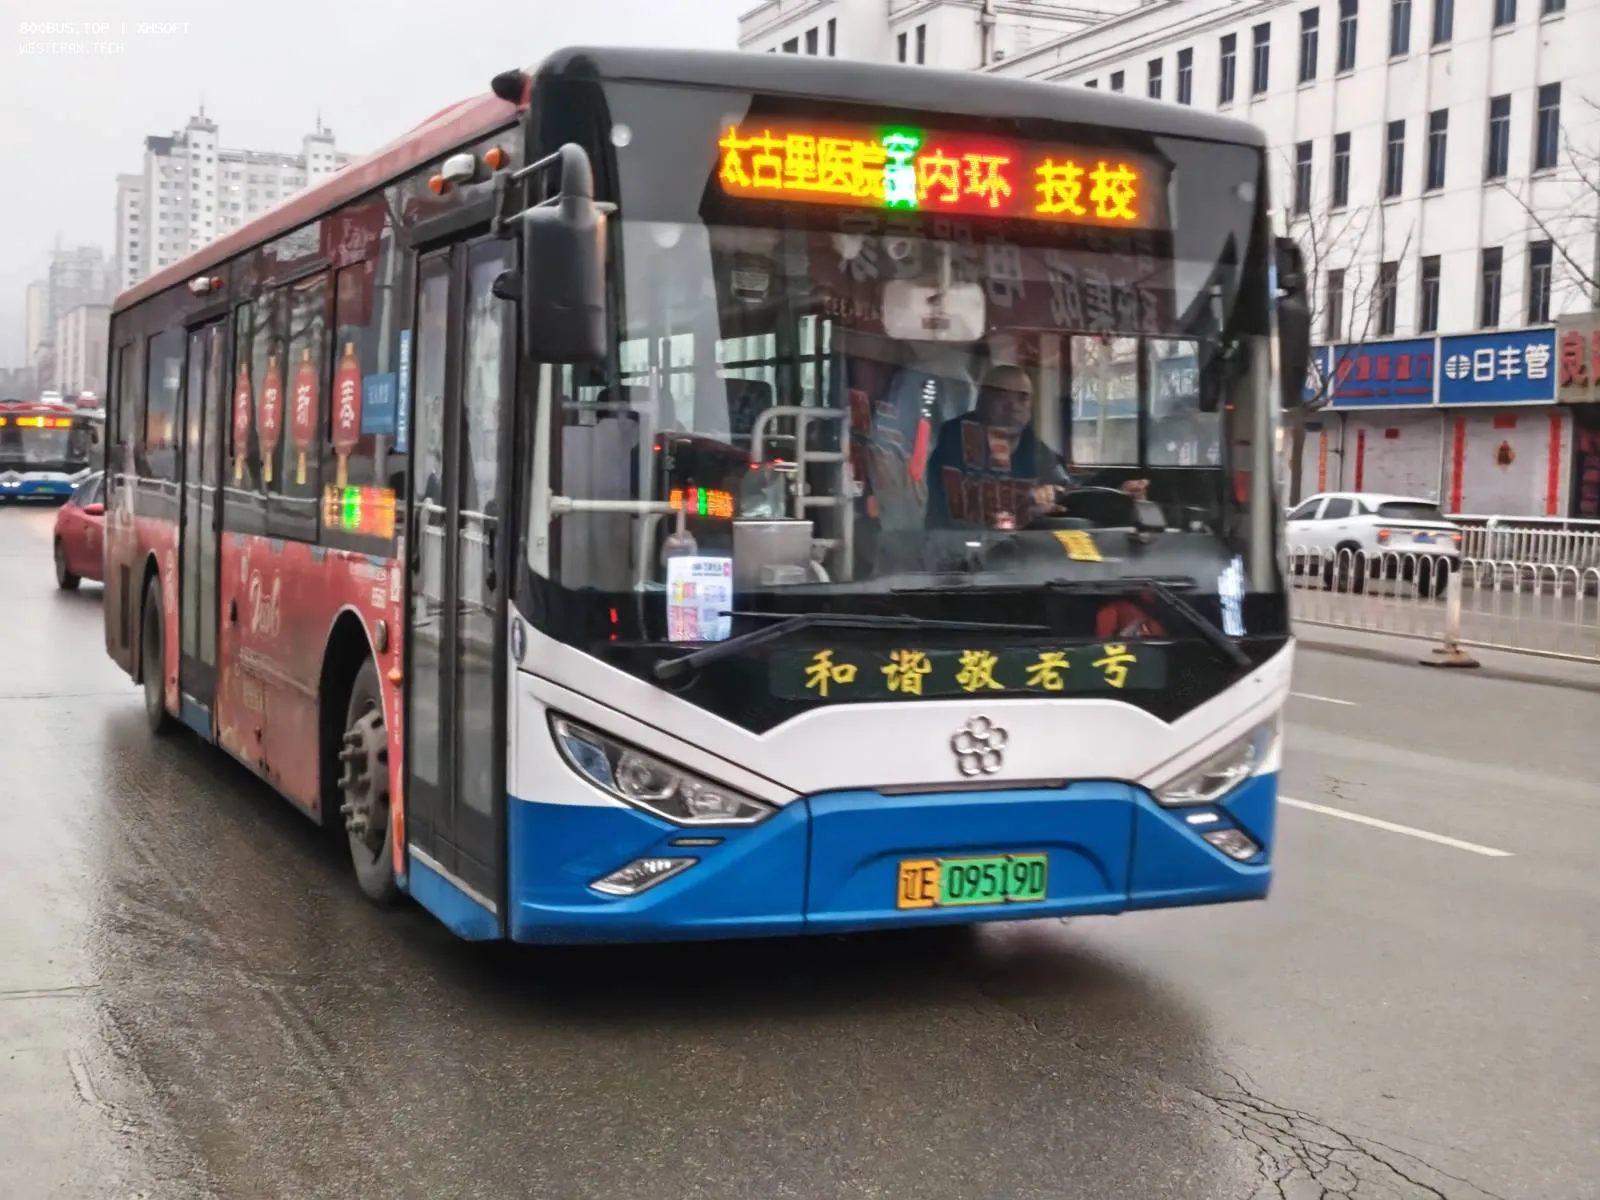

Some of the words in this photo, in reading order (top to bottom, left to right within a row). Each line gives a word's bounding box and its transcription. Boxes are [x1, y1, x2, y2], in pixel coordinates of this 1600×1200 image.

[918, 150, 1012, 207] 内环
[1035, 158, 1137, 220] 技校
[1474, 344, 1550, 382] 日丰管
[805, 644, 1137, 697] 和谐敬老号
[949, 862, 1045, 898] 09519D
